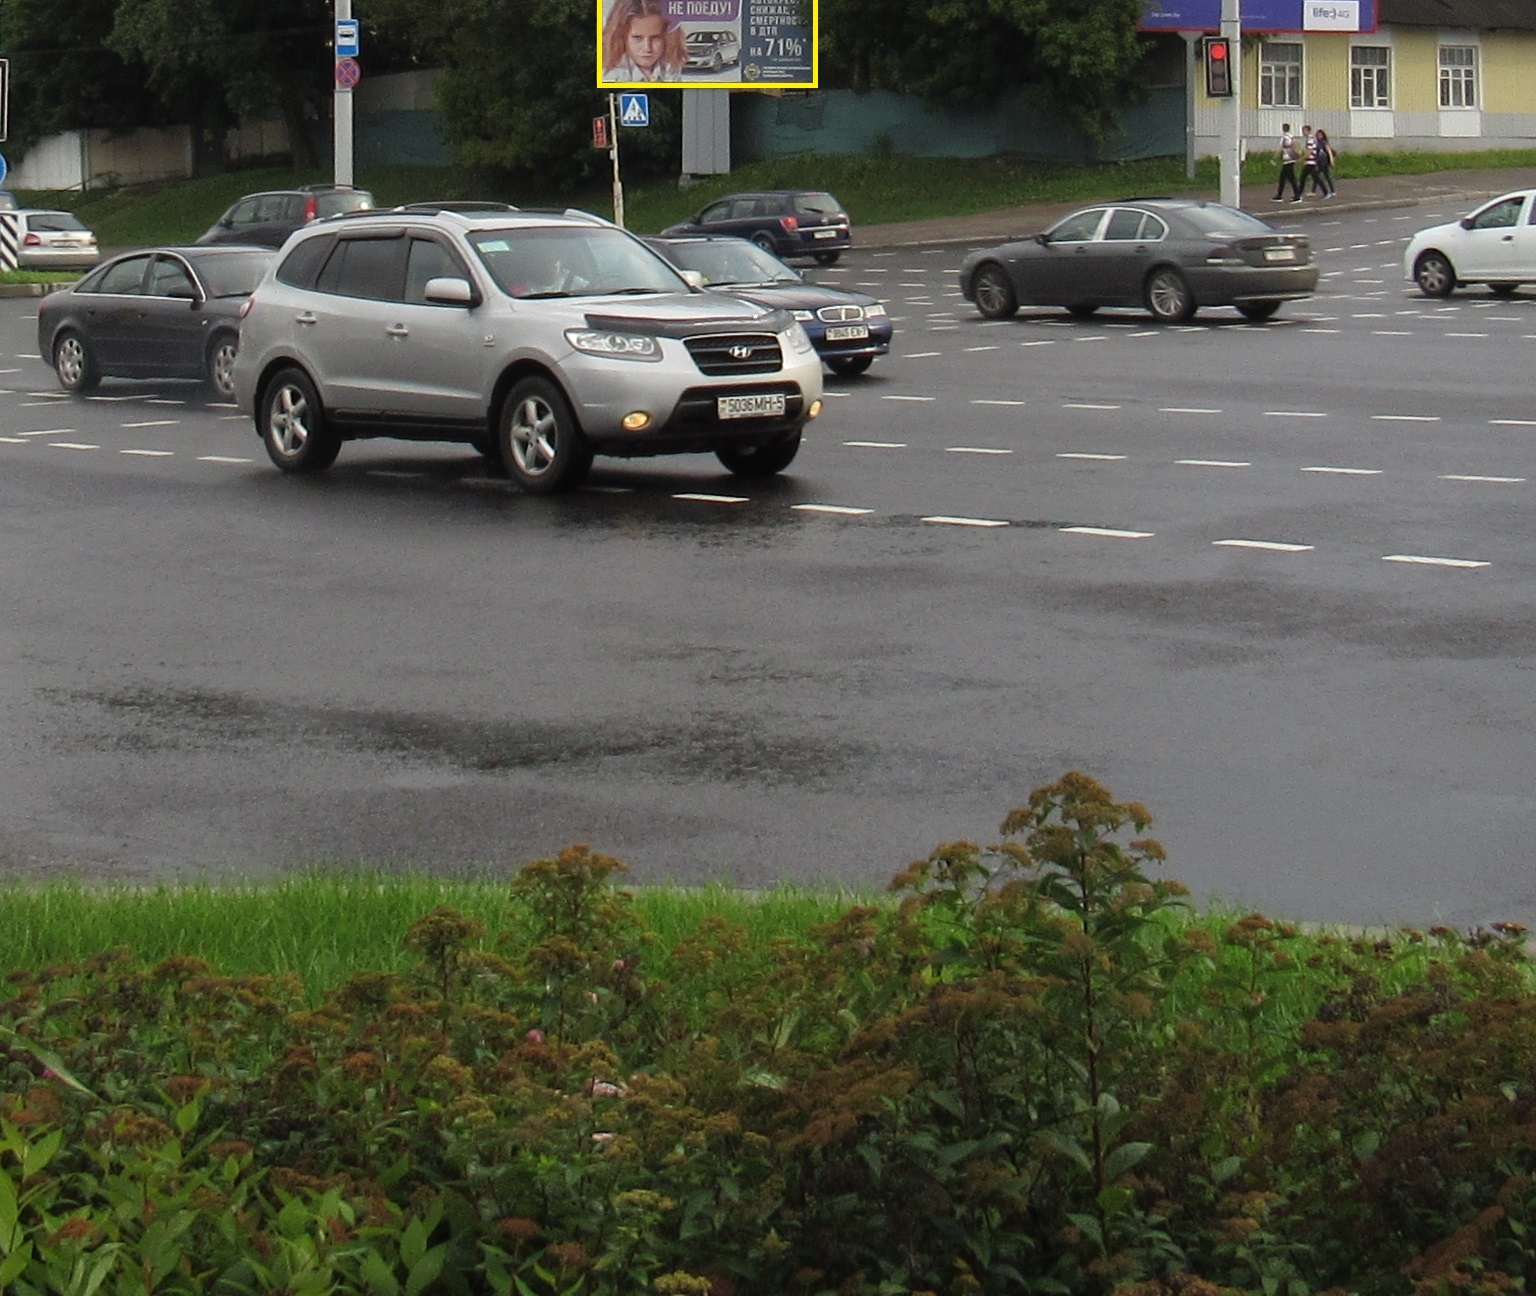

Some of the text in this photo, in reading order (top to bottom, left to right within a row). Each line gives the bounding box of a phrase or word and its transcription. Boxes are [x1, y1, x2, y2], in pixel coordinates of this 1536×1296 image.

[669, 1, 731, 16] НЕ ПОЕДУ!
[750, 16, 808, 25] СМЕРТНОС
[750, 47, 763, 57] НА
